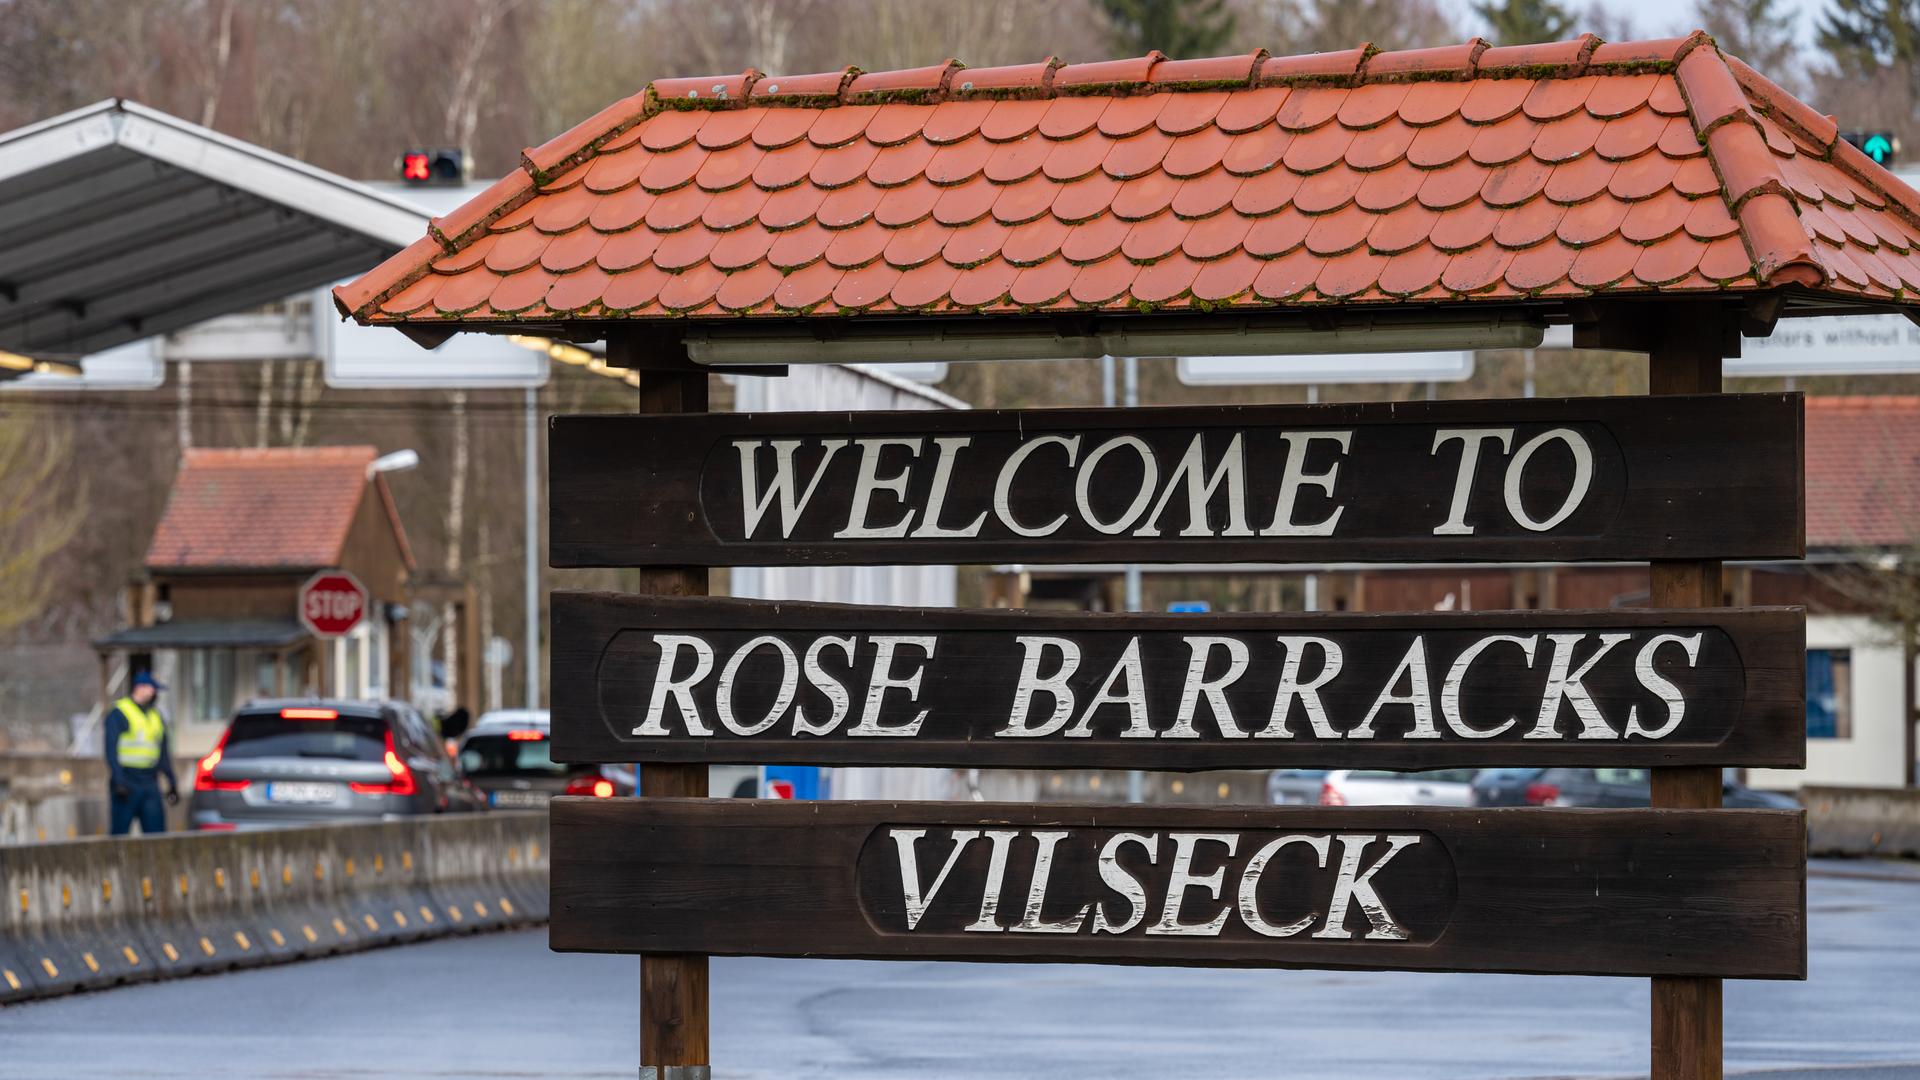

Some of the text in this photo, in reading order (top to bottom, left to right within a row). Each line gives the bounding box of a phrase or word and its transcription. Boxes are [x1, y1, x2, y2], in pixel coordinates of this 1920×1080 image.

[732, 428, 1593, 539] WELCOME TO
[306, 590, 359, 619] STOP
[631, 632, 1703, 740] ROSE BARRACKS
[889, 829, 1421, 941] VILSECK
